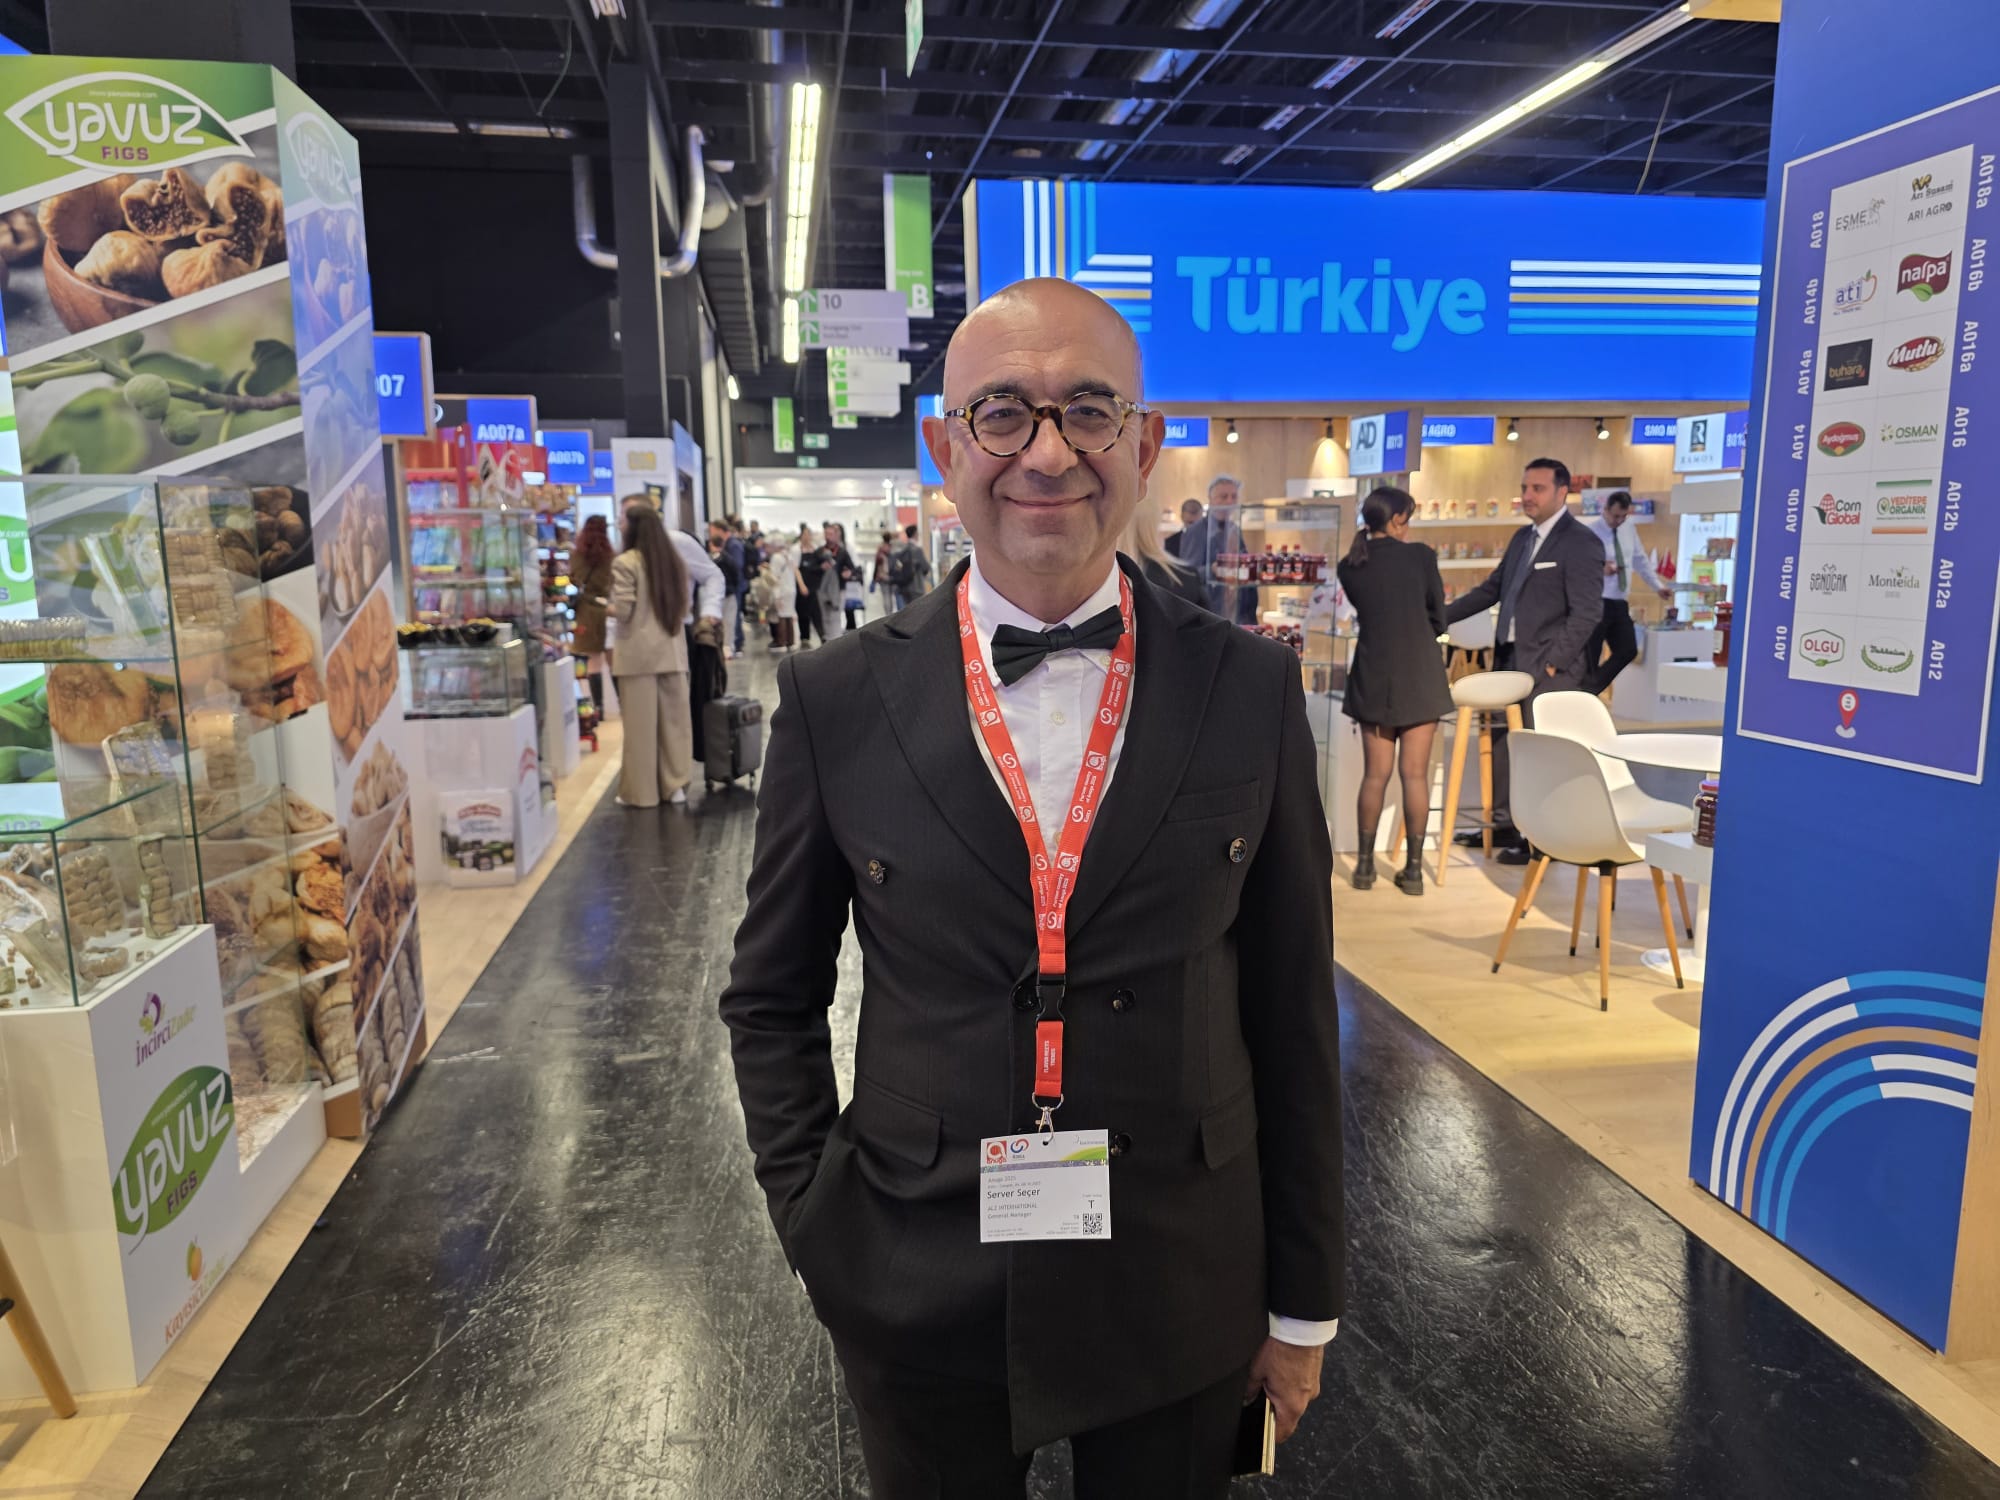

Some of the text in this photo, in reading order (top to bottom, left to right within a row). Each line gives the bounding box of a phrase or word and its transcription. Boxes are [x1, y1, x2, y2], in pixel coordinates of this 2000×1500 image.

[45, 101, 205, 157] yavuz
[101, 146, 149, 161] FIGS
[1976, 154, 1995, 209] A018a
[1810, 210, 1825, 249] A018
[1968, 238, 1987, 292] A016b
[823, 294, 843, 310] 10
[912, 284, 929, 310] B
[1176, 256, 1487, 352] Türkiye
[1803, 278, 1819, 325] A014b
[1887, 339, 1938, 366] Mutlu
[1959, 320, 1979, 373] A016a
[1797, 349, 1813, 395] A014a
[477, 423, 525, 441] A007a
[1791, 423, 1806, 460] A014
[1895, 424, 1939, 439] OSMAN
[1952, 406, 1970, 448] A016
[1785, 488, 1800, 533] A010b
[1826, 512, 1860, 525] Global
[1943, 480, 1962, 532] A012b
[1779, 556, 1794, 599] A010a
[1935, 558, 1954, 609] A012a
[1774, 625, 1788, 661] A010
[1804, 639, 1840, 654] OLGU
[1928, 639, 1946, 681] A012
[119, 1071, 230, 1256] yavuz
[167, 1169, 198, 1215] FIGS
[987, 1188, 1041, 1199] Server Seçer
[1088, 1200, 1095, 1209] T
